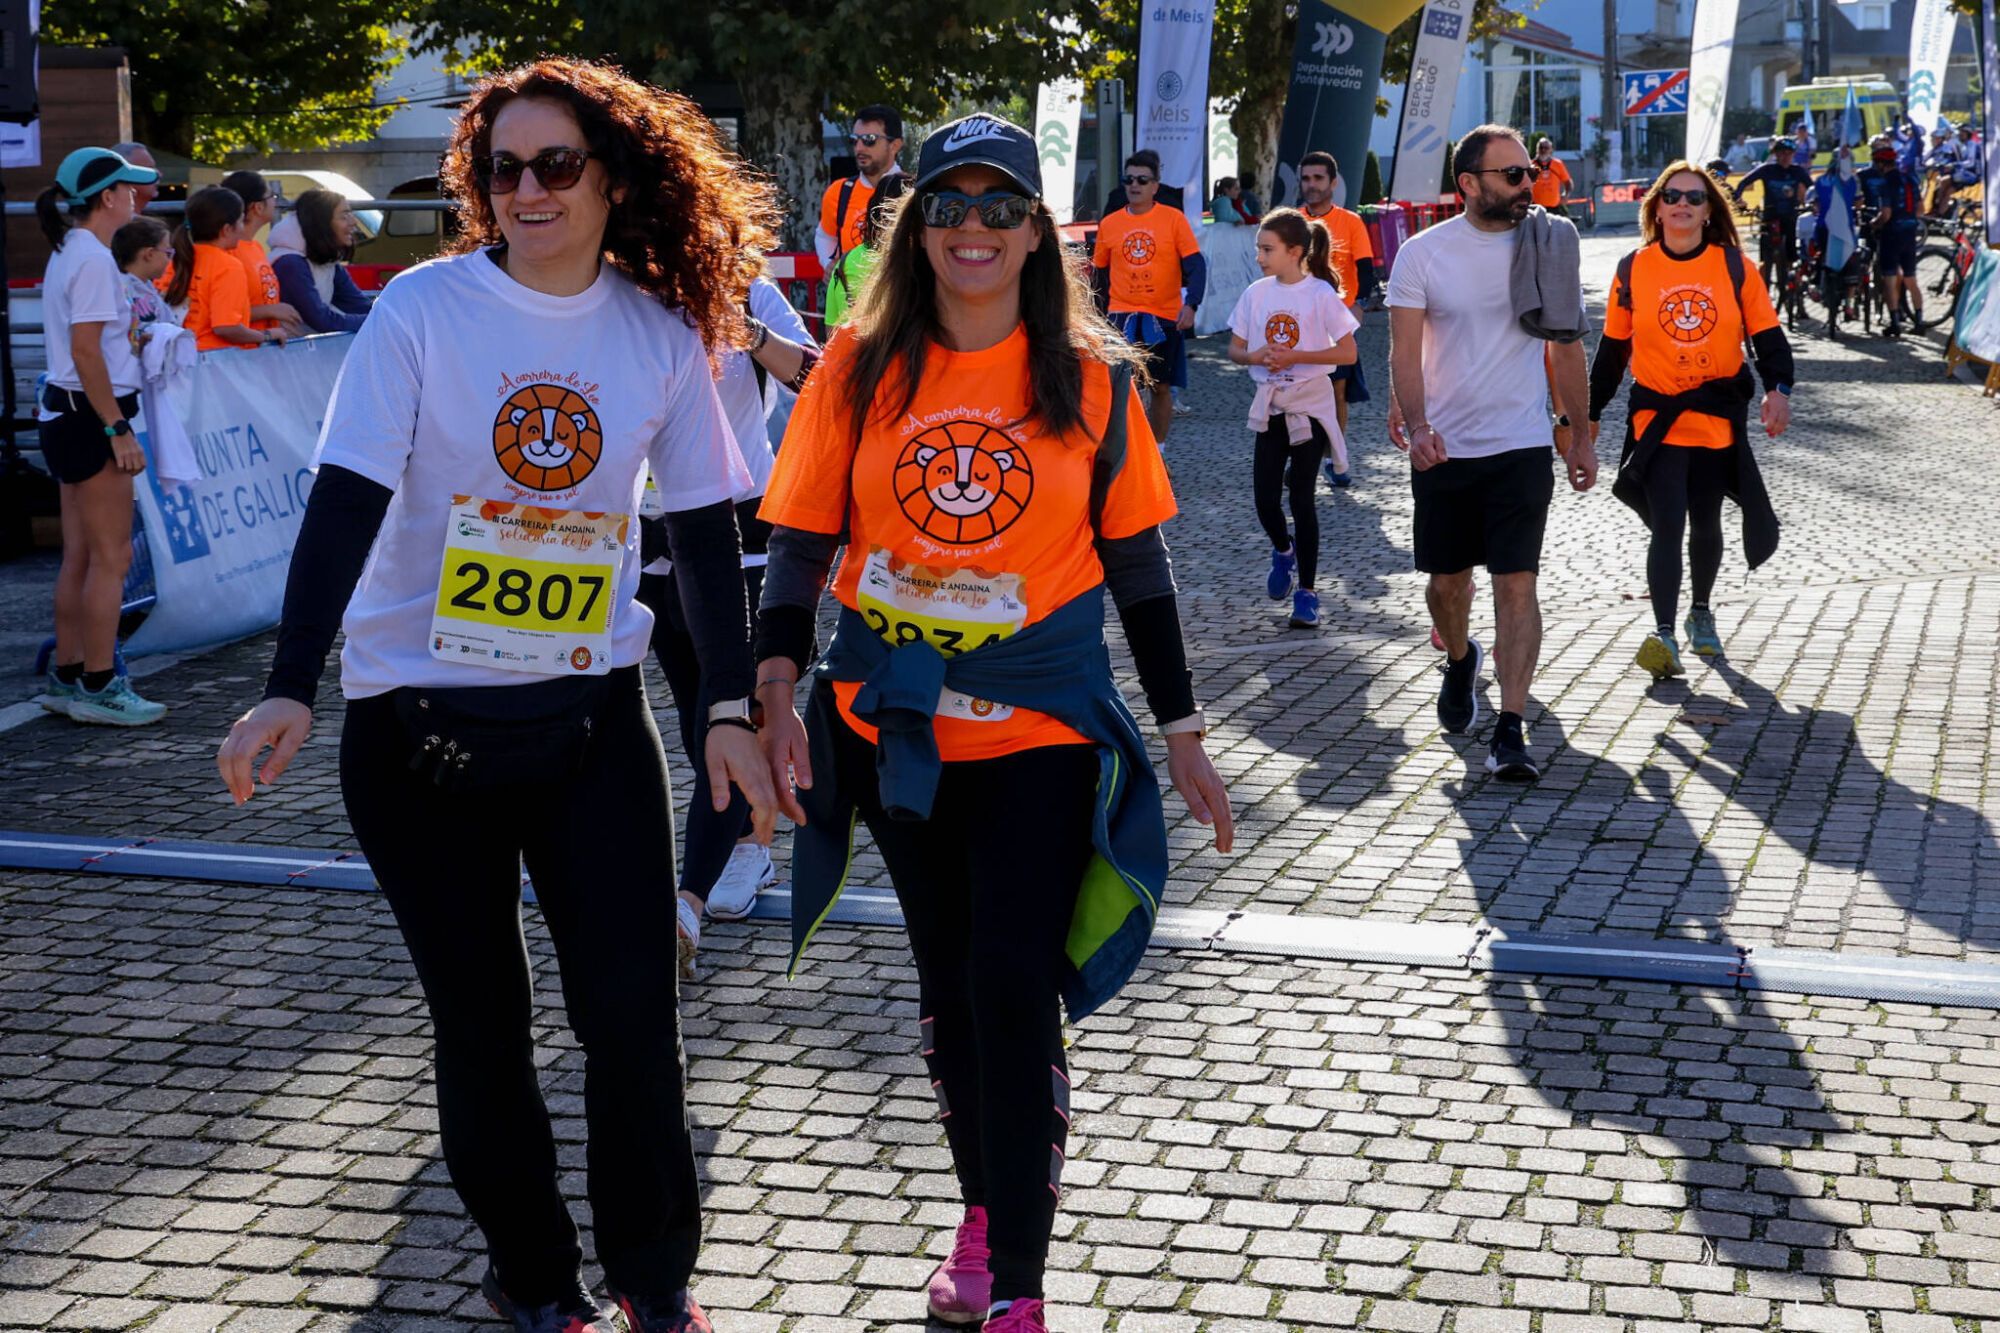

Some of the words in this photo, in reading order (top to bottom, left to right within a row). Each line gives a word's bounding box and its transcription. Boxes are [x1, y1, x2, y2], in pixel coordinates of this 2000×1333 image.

[1170, 9, 1204, 23] Meis
[1296, 61, 1363, 77] Deputación
[1295, 73, 1361, 89] Pontevedra
[1421, 65, 1438, 117] GALEGO
[1151, 104, 1190, 122] Meis
[952, 119, 1002, 139] NIKE
[497, 372, 518, 398] A
[515, 369, 562, 383] carreira
[581, 381, 600, 405] Leo
[901, 413, 927, 436] A
[924, 405, 982, 424] carreira
[503, 481, 536, 500] sempre
[538, 493, 552, 501] sae
[563, 485, 578, 500] sol
[202, 491, 235, 539] DE
[501, 516, 548, 530] CARREIRA
[551, 523, 556, 531] E
[558, 524, 596, 534] ANDAINA
[500, 526, 558, 545] solidaria
[562, 534, 576, 547] de
[912, 535, 951, 558] sempre
[954, 549, 973, 558] sae
[985, 536, 1003, 552] sol
[450, 561, 604, 622] 2807
[897, 573, 938, 590] CARREIRA
[948, 582, 991, 593] ANDAINA
[951, 591, 965, 603] de
